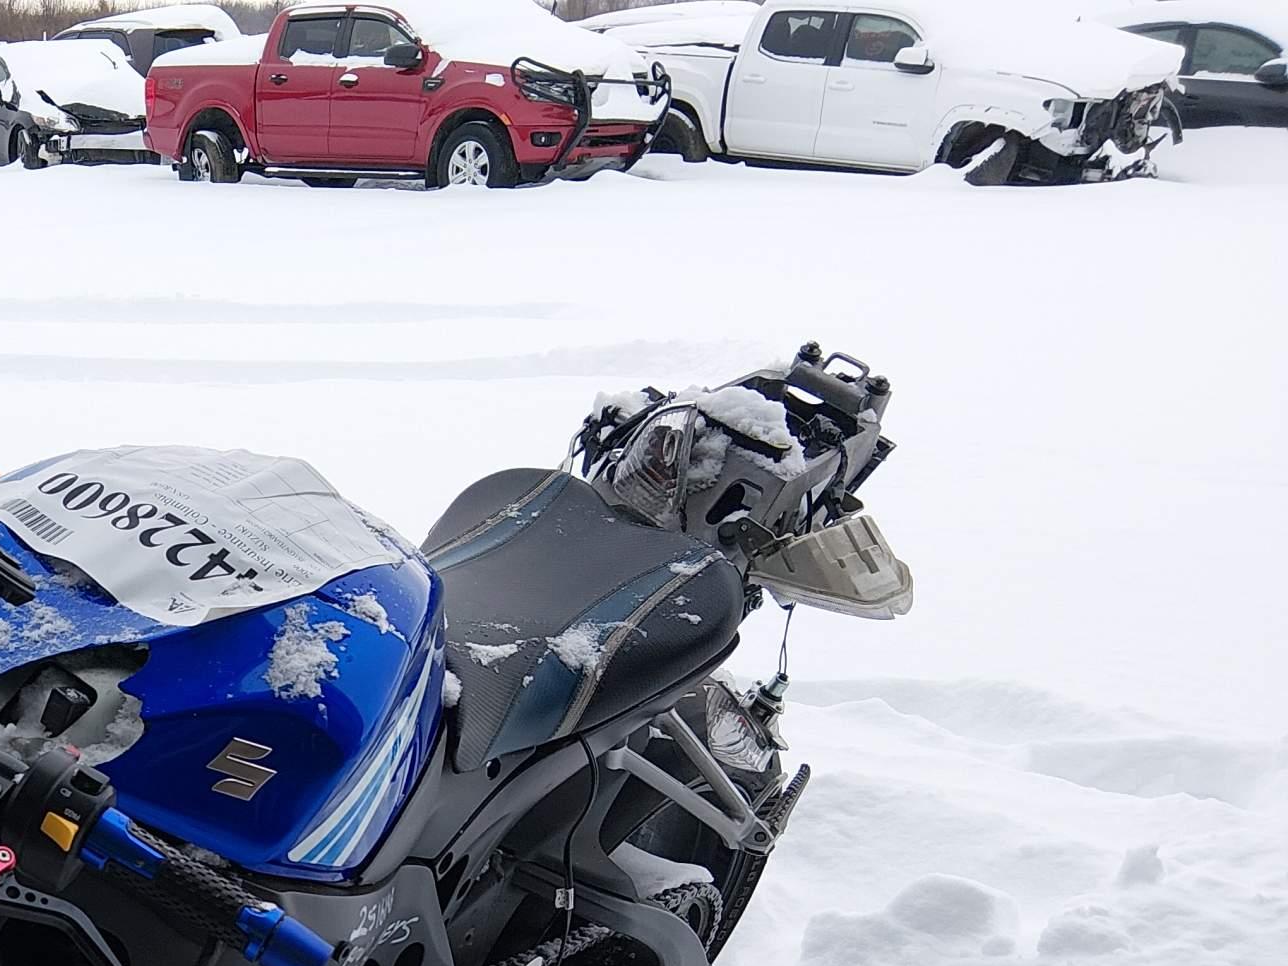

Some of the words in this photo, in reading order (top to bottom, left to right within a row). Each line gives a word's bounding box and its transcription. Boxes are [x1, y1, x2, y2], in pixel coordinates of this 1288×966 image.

[154, 492, 210, 527] Columbus
[217, 528, 275, 572] Insurance
[235, 523, 270, 552] SUZUKI
